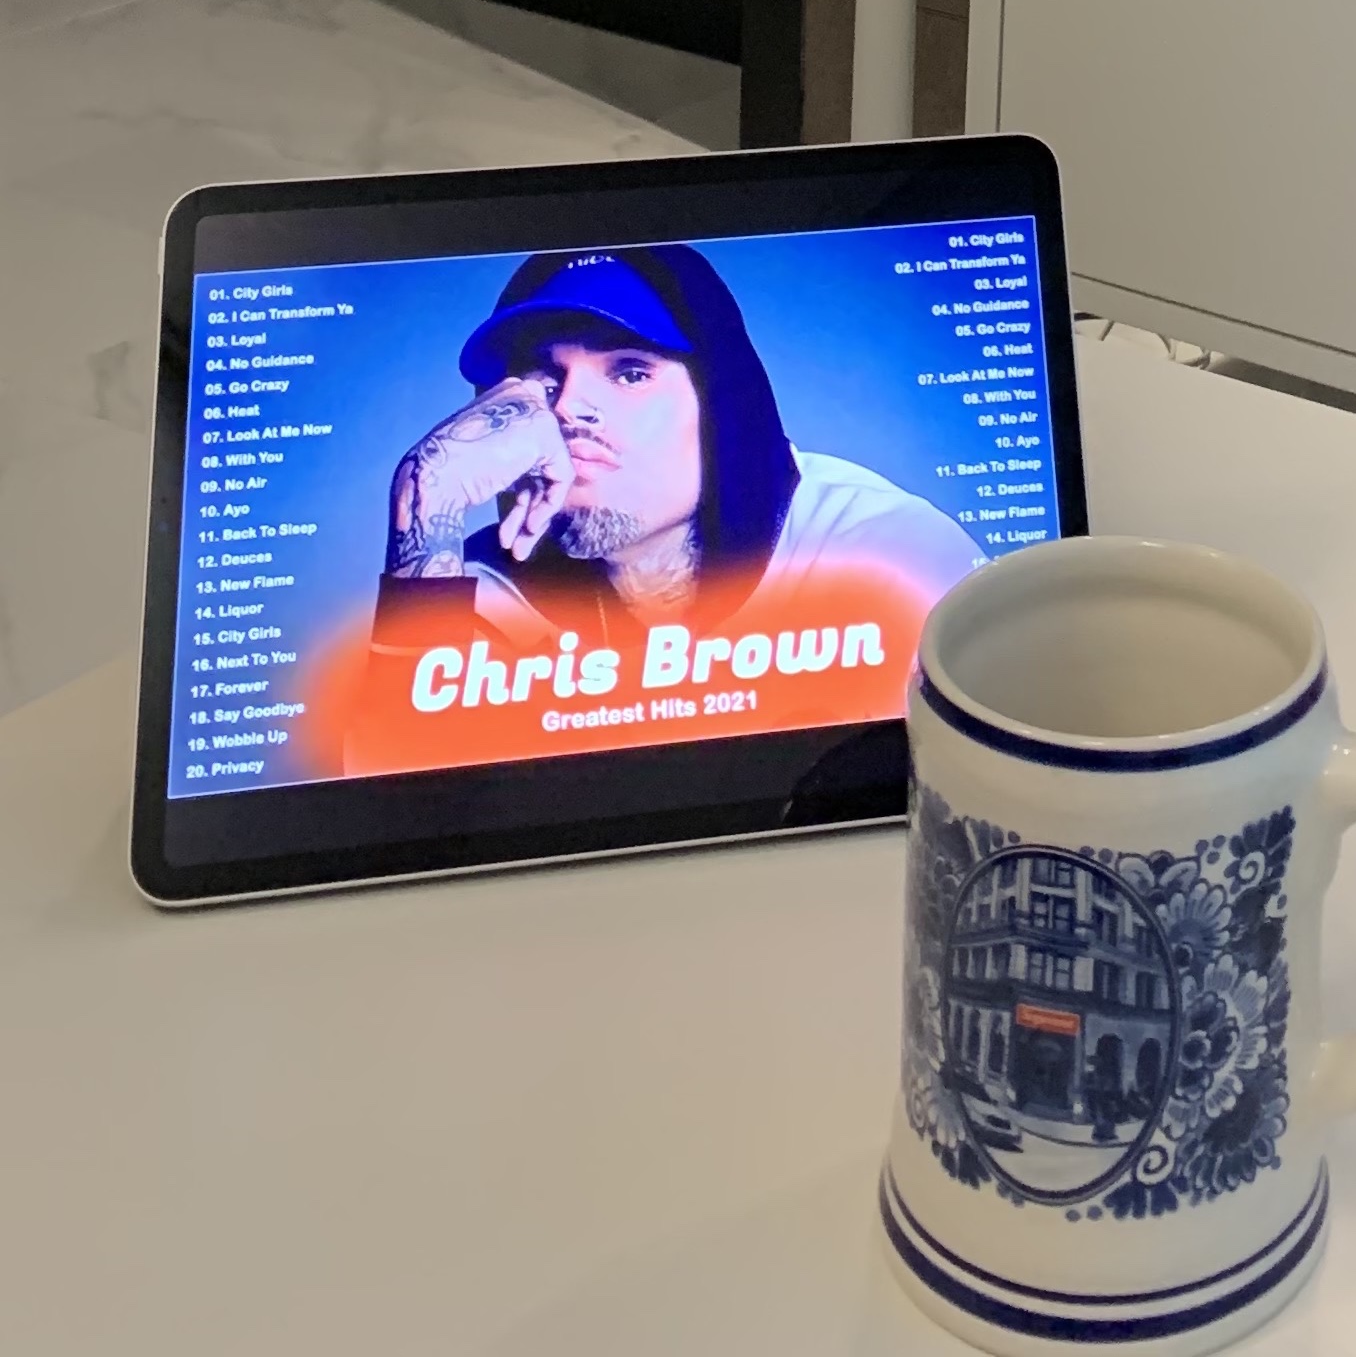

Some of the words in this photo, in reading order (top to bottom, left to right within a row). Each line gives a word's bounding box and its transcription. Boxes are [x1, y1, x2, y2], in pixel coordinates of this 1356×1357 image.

[233, 287, 259, 300] City
[262, 285, 293, 297] Girls
[240, 310, 266, 322] Can
[268, 306, 335, 319] Transform
[337, 304, 353, 314] Ya
[231, 333, 266, 347] Loyal
[230, 358, 249, 369] No
[251, 355, 314, 368] Guidance
[229, 382, 248, 394] Go
[251, 380, 289, 392] Crazy
[228, 405, 260, 417] Heat
[227, 429, 259, 442] Look
[262, 427, 278, 439] At
[281, 426, 300, 437] Me
[303, 424, 332, 435] Now
[226, 453, 256, 466] With
[259, 452, 283, 463] You
[225, 479, 244, 491] No
[246, 477, 267, 489] Air
[223, 504, 250, 517] Ayo
[223, 527, 257, 541] Back
[260, 526, 276, 537] To
[279, 524, 317, 536] Sleep
[221, 553, 272, 566] Deuces
[220, 580, 251, 591] New
[253, 576, 294, 588] Flame
[219, 604, 264, 618] Liquor
[218, 630, 245, 644] City
[248, 626, 281, 640] Girls
[217, 655, 249, 669] Next
[251, 653, 268, 665] To
[271, 651, 296, 663] You
[411, 632, 621, 713] Chris
[641, 622, 886, 689] Brown
[215, 681, 269, 696] Forever
[214, 709, 240, 723] Say
[243, 702, 304, 719] Goodbye
[541, 704, 645, 732] Greatest
[650, 699, 697, 720] Hits
[703, 692, 758, 715] 2021
[213, 732, 264, 748] Wobble
[267, 730, 288, 744] Up
[212, 761, 264, 776] Privacy
